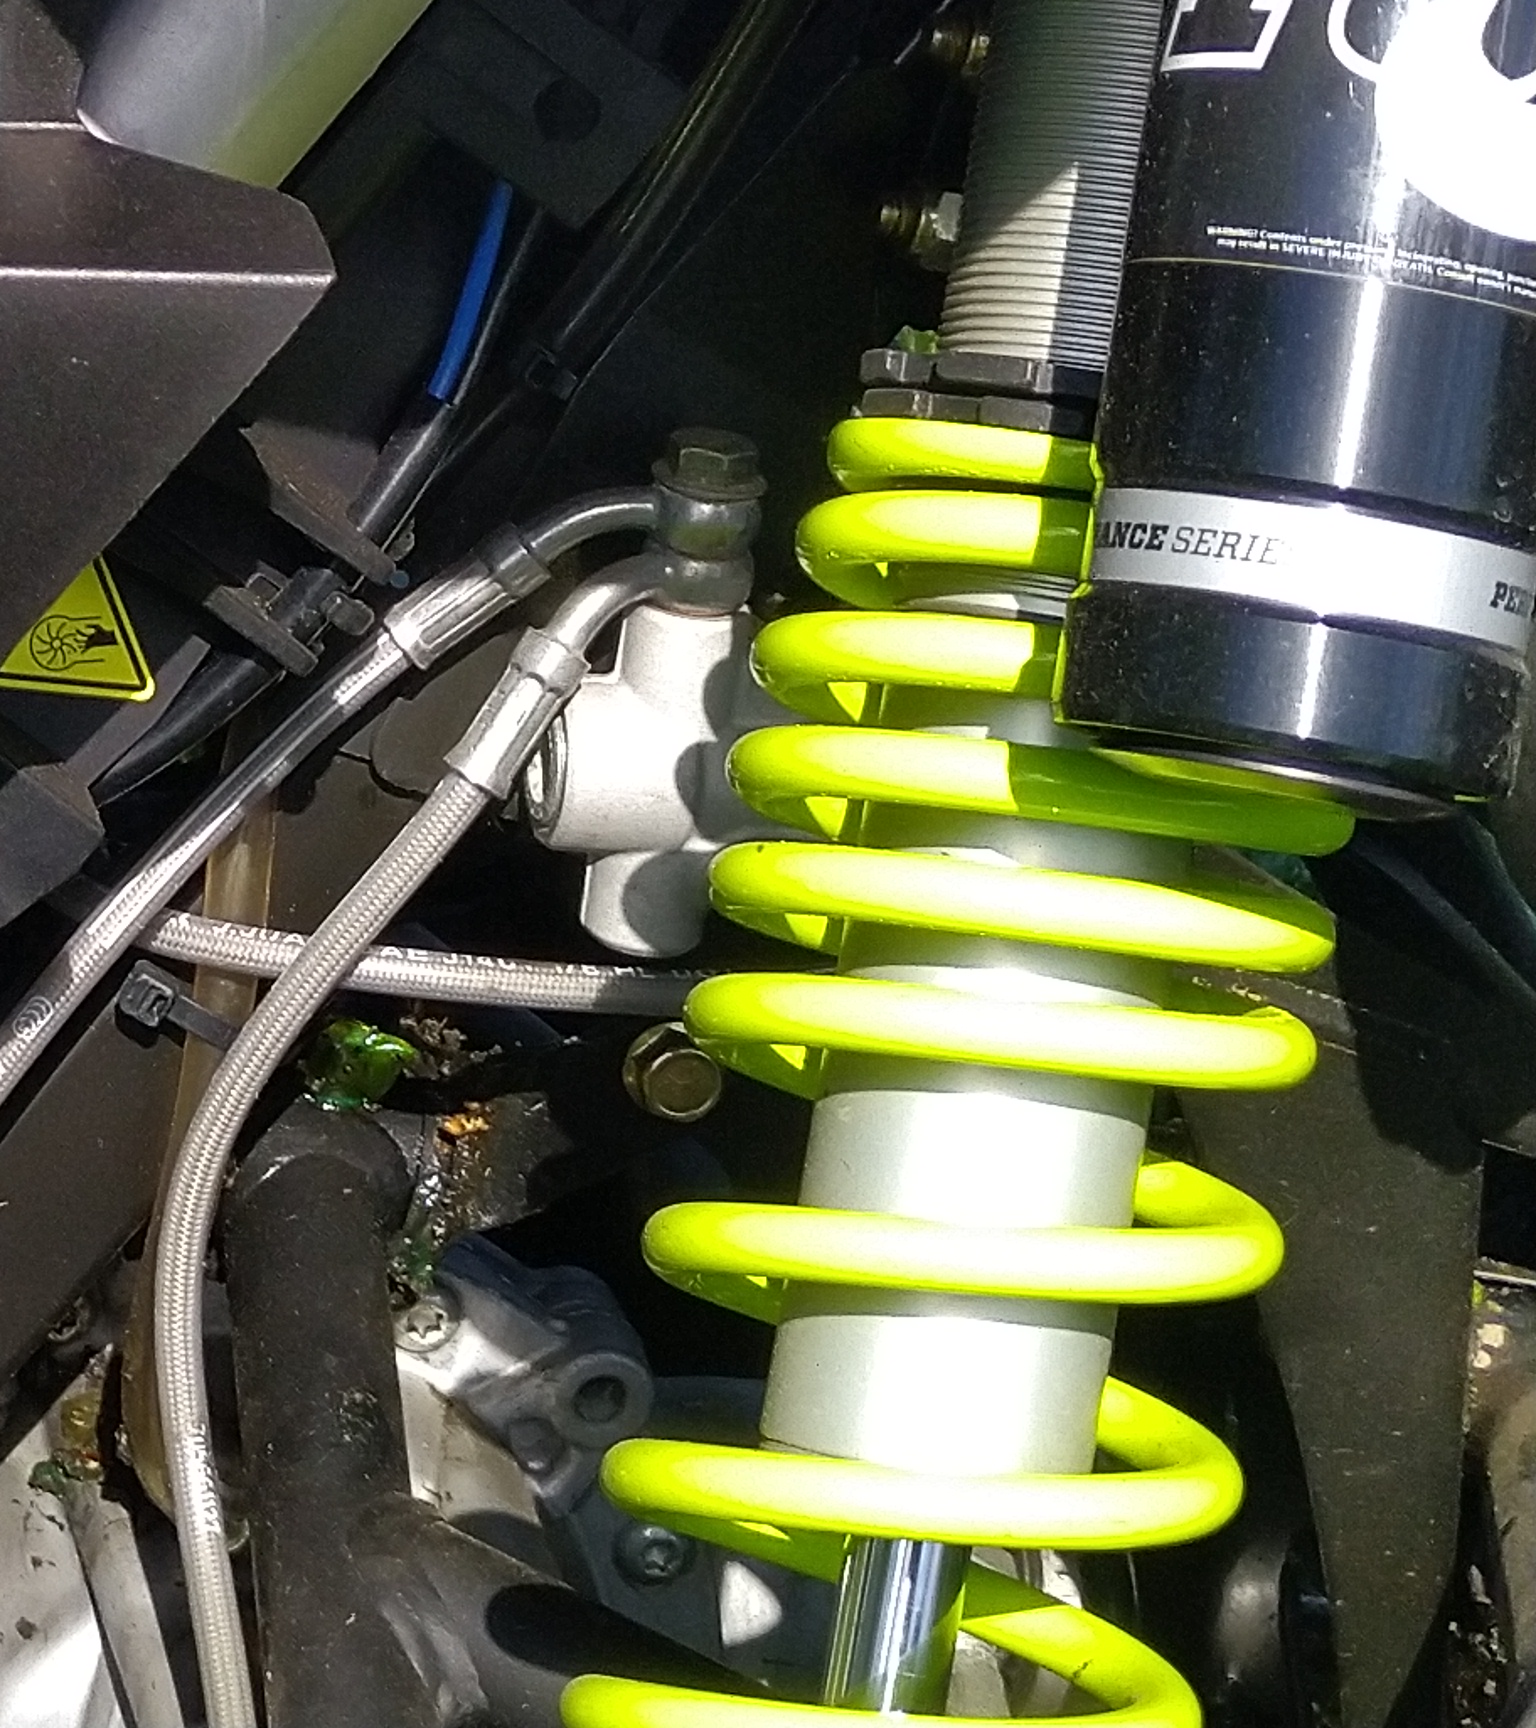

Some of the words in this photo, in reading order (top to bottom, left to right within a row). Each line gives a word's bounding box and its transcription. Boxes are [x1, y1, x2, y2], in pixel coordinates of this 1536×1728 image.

[1096, 521, 1169, 551] ANCE
[1171, 526, 1284, 566] SERIE
[380, 945, 429, 962] AE
